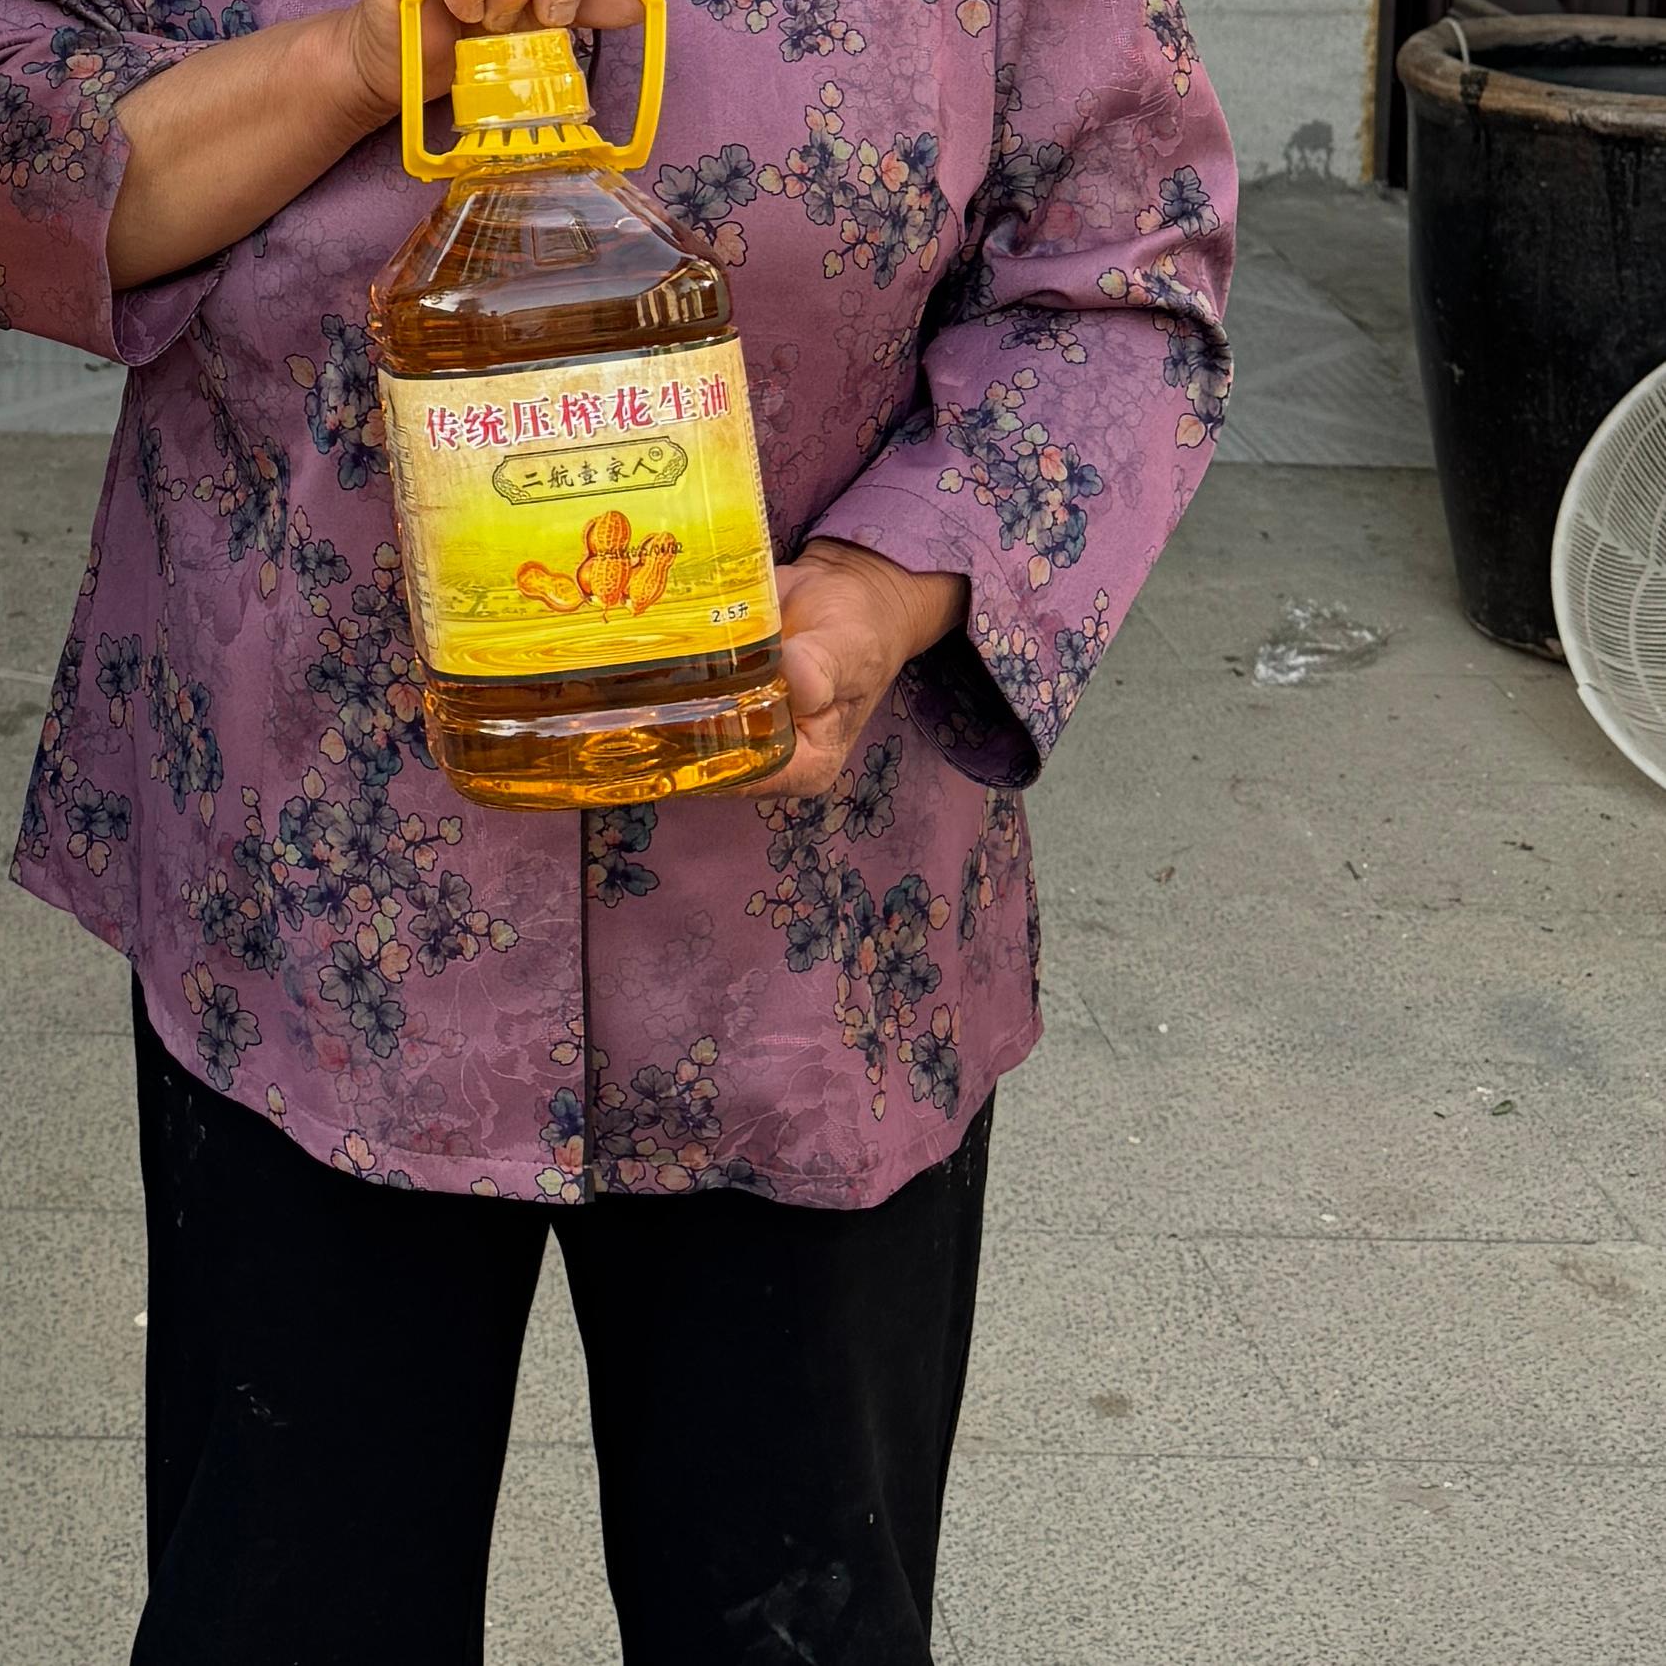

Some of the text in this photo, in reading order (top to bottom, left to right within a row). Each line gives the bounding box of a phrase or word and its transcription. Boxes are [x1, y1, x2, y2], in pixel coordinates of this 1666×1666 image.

[426, 373, 731, 451] 传统压榨花生油
[521, 456, 658, 489] 二航壹家人
